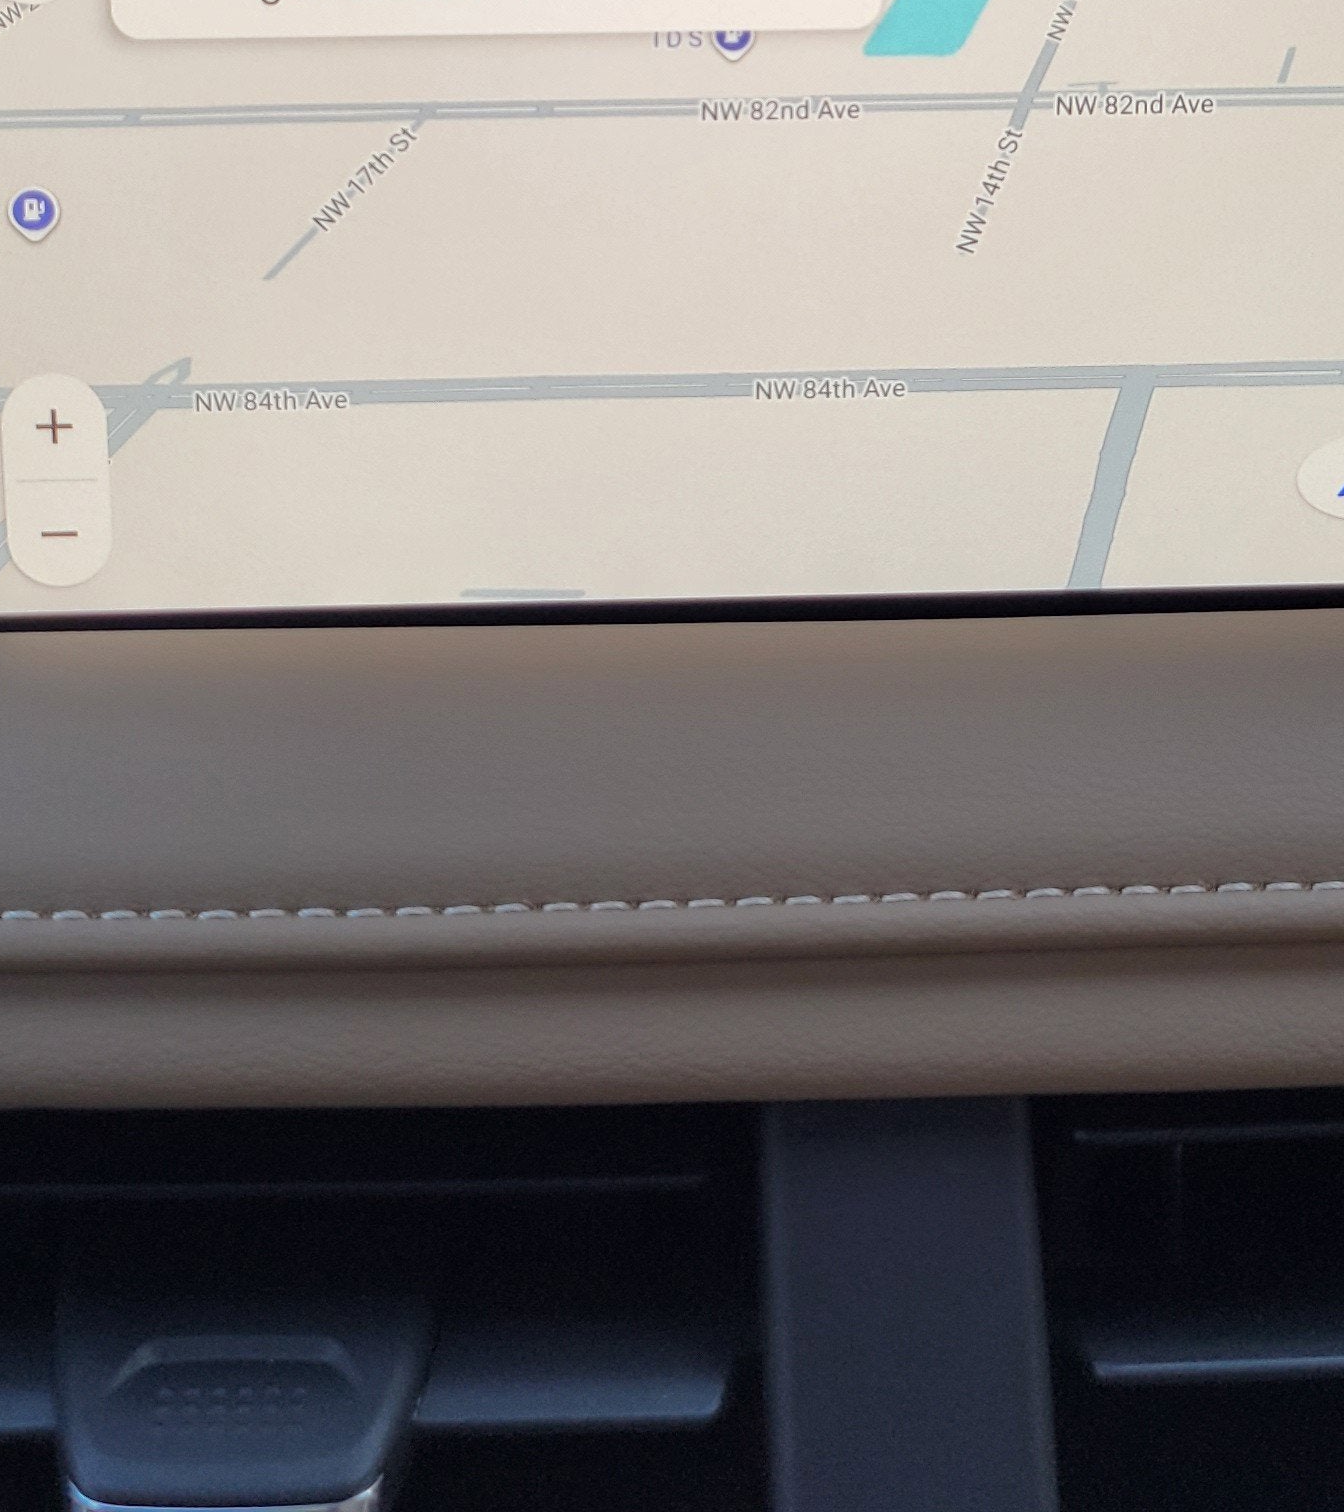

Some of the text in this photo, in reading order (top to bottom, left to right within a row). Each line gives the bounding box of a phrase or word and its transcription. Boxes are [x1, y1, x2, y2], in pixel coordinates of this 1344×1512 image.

[1047, 5, 1074, 42] NW
[701, 98, 862, 123] NW 82nd Ave
[1056, 93, 1215, 116] NW 82nd Ave
[312, 127, 418, 232] NW 17th St
[955, 128, 1023, 254] NW 14th St
[195, 389, 348, 412] NW 84th Ave
[755, 377, 907, 400] NW 84th Ave
